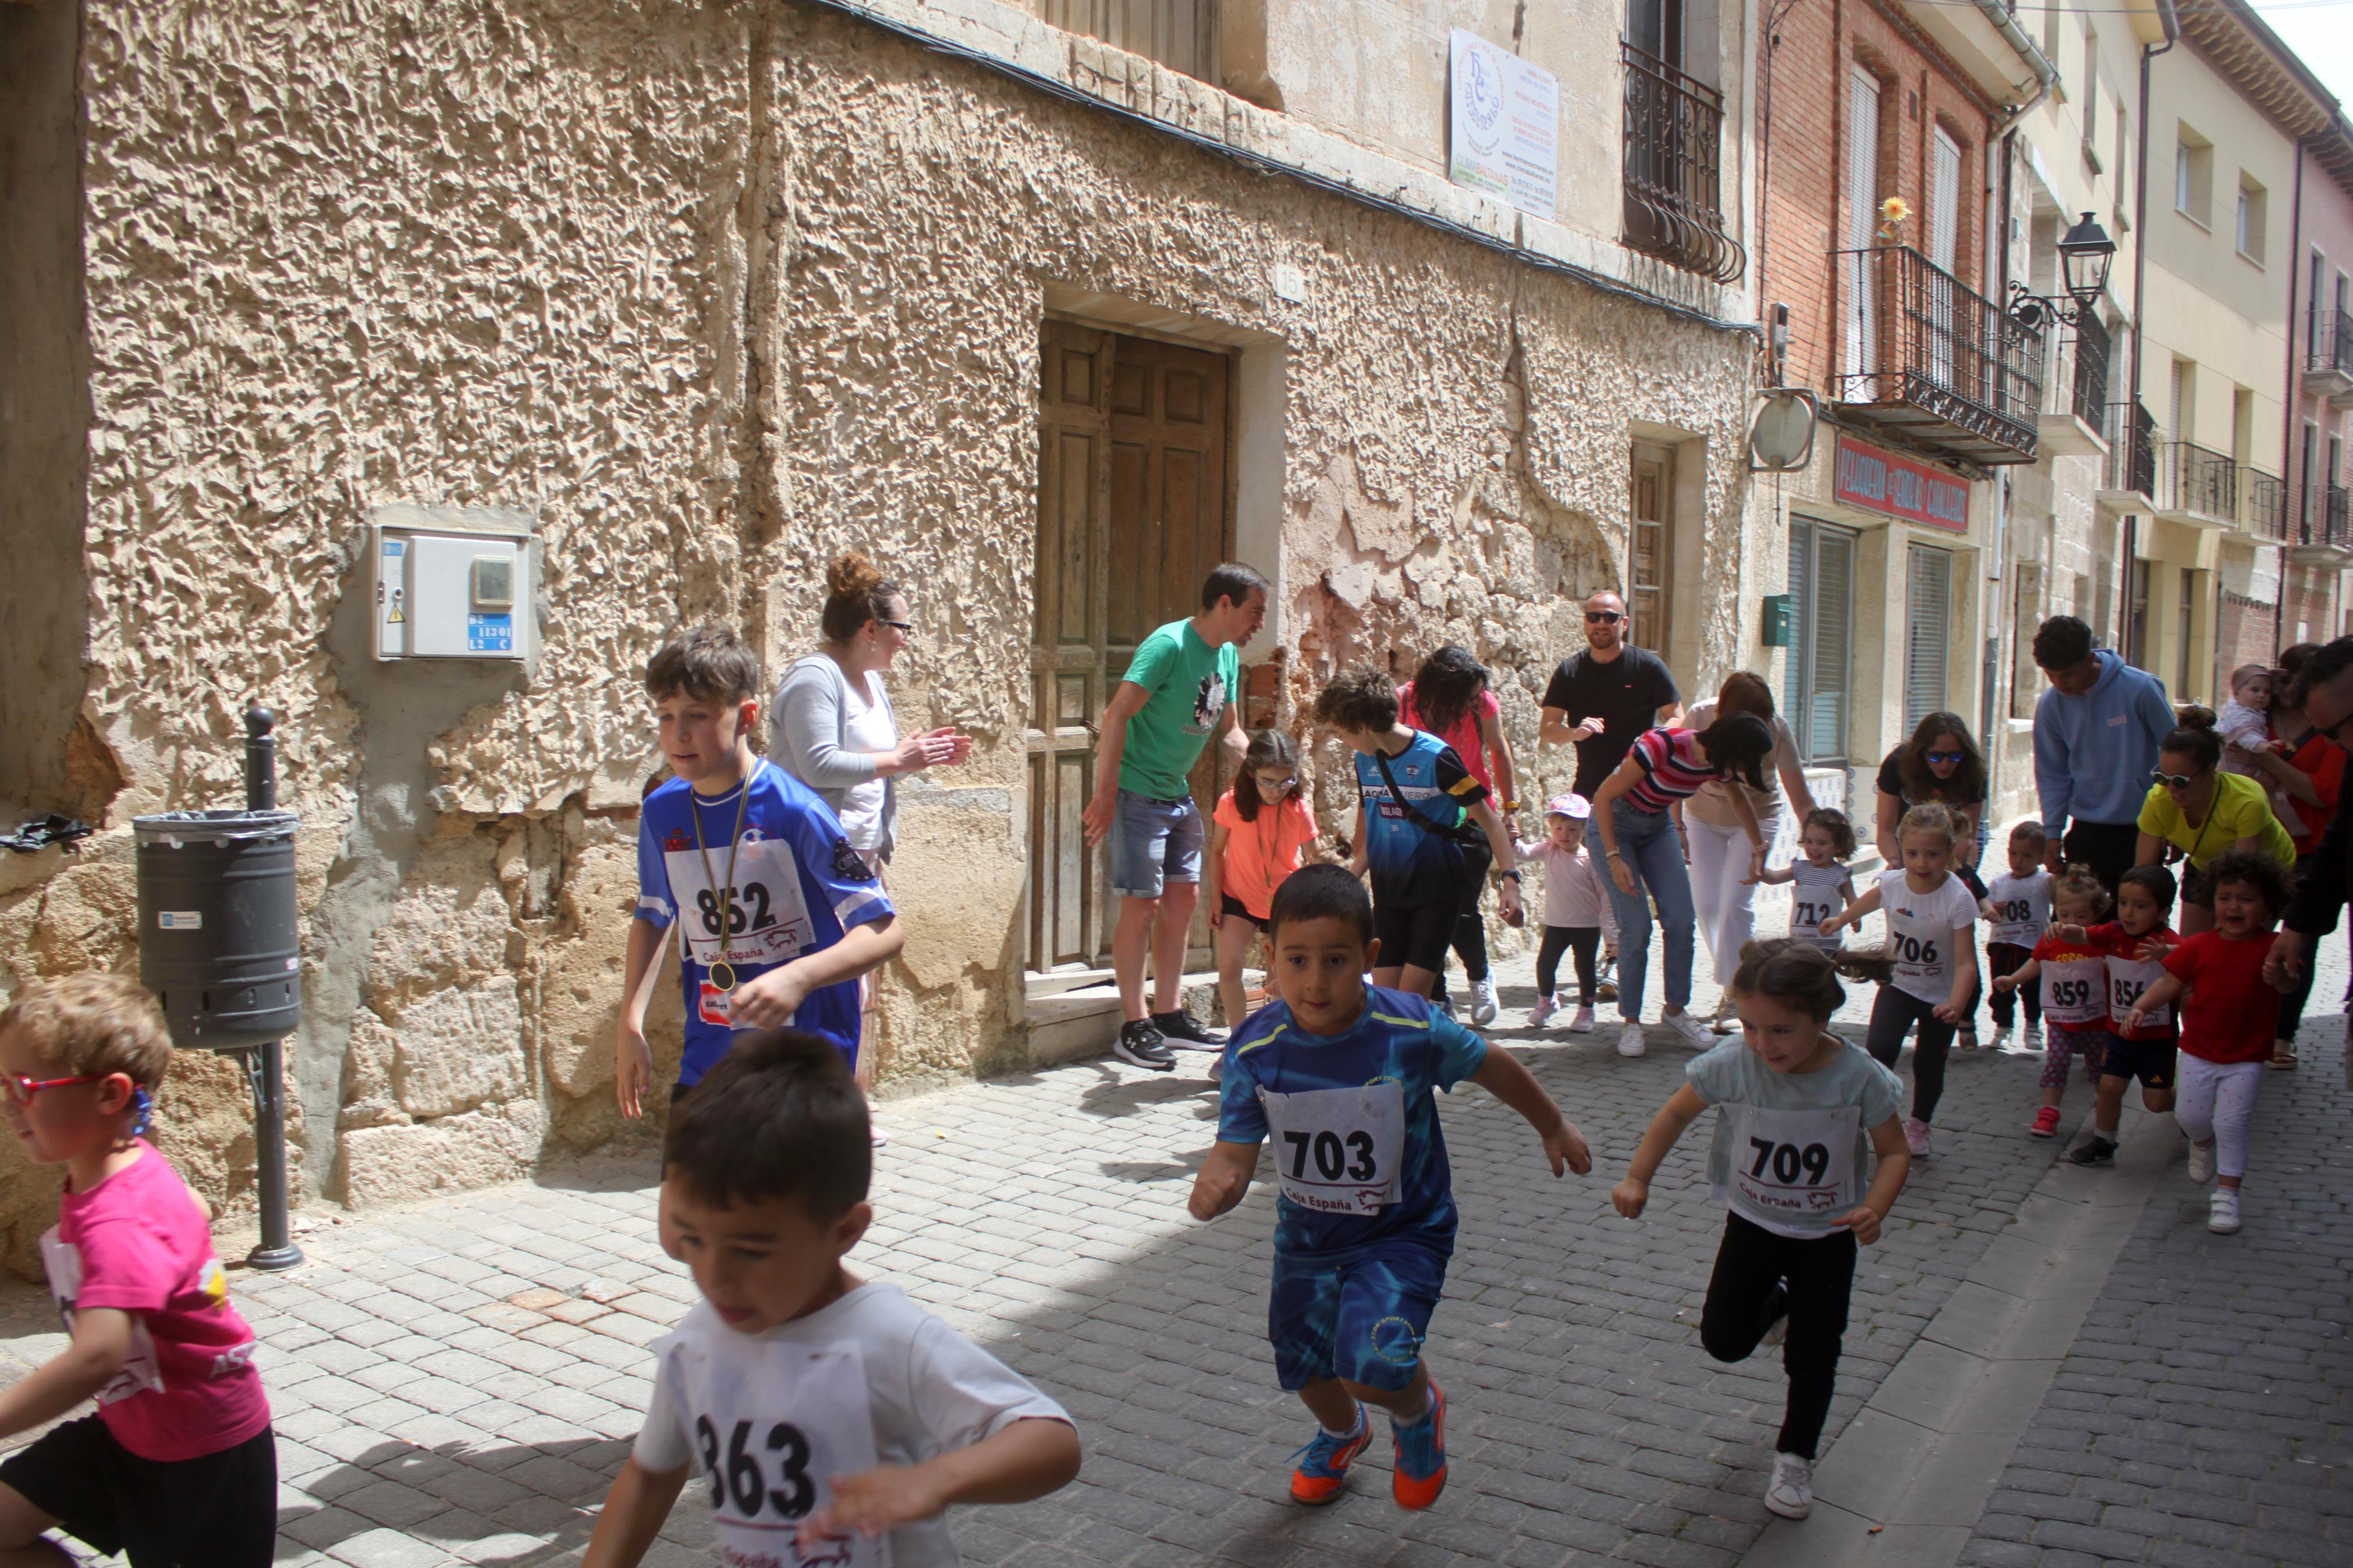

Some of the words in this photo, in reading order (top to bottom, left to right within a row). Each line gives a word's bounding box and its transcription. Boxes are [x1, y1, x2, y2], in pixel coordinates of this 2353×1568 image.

[1282, 269, 1298, 294] 15
[469, 614, 484, 624] B2
[469, 639, 484, 649] L2
[499, 639, 507, 649] C
[697, 882, 776, 935] 852
[1795, 902, 1830, 925] 712
[2006, 899, 2030, 922] 08
[727, 948, 764, 962] España
[1893, 931, 1937, 963] 706
[2053, 980, 2089, 1006] 859
[1283, 1130, 1376, 1181] 703
[1750, 1136, 1829, 1185] 709
[1286, 1187, 1306, 1204] Caja
[1309, 1196, 1351, 1211] España
[1740, 1182, 1758, 1200] Caja
